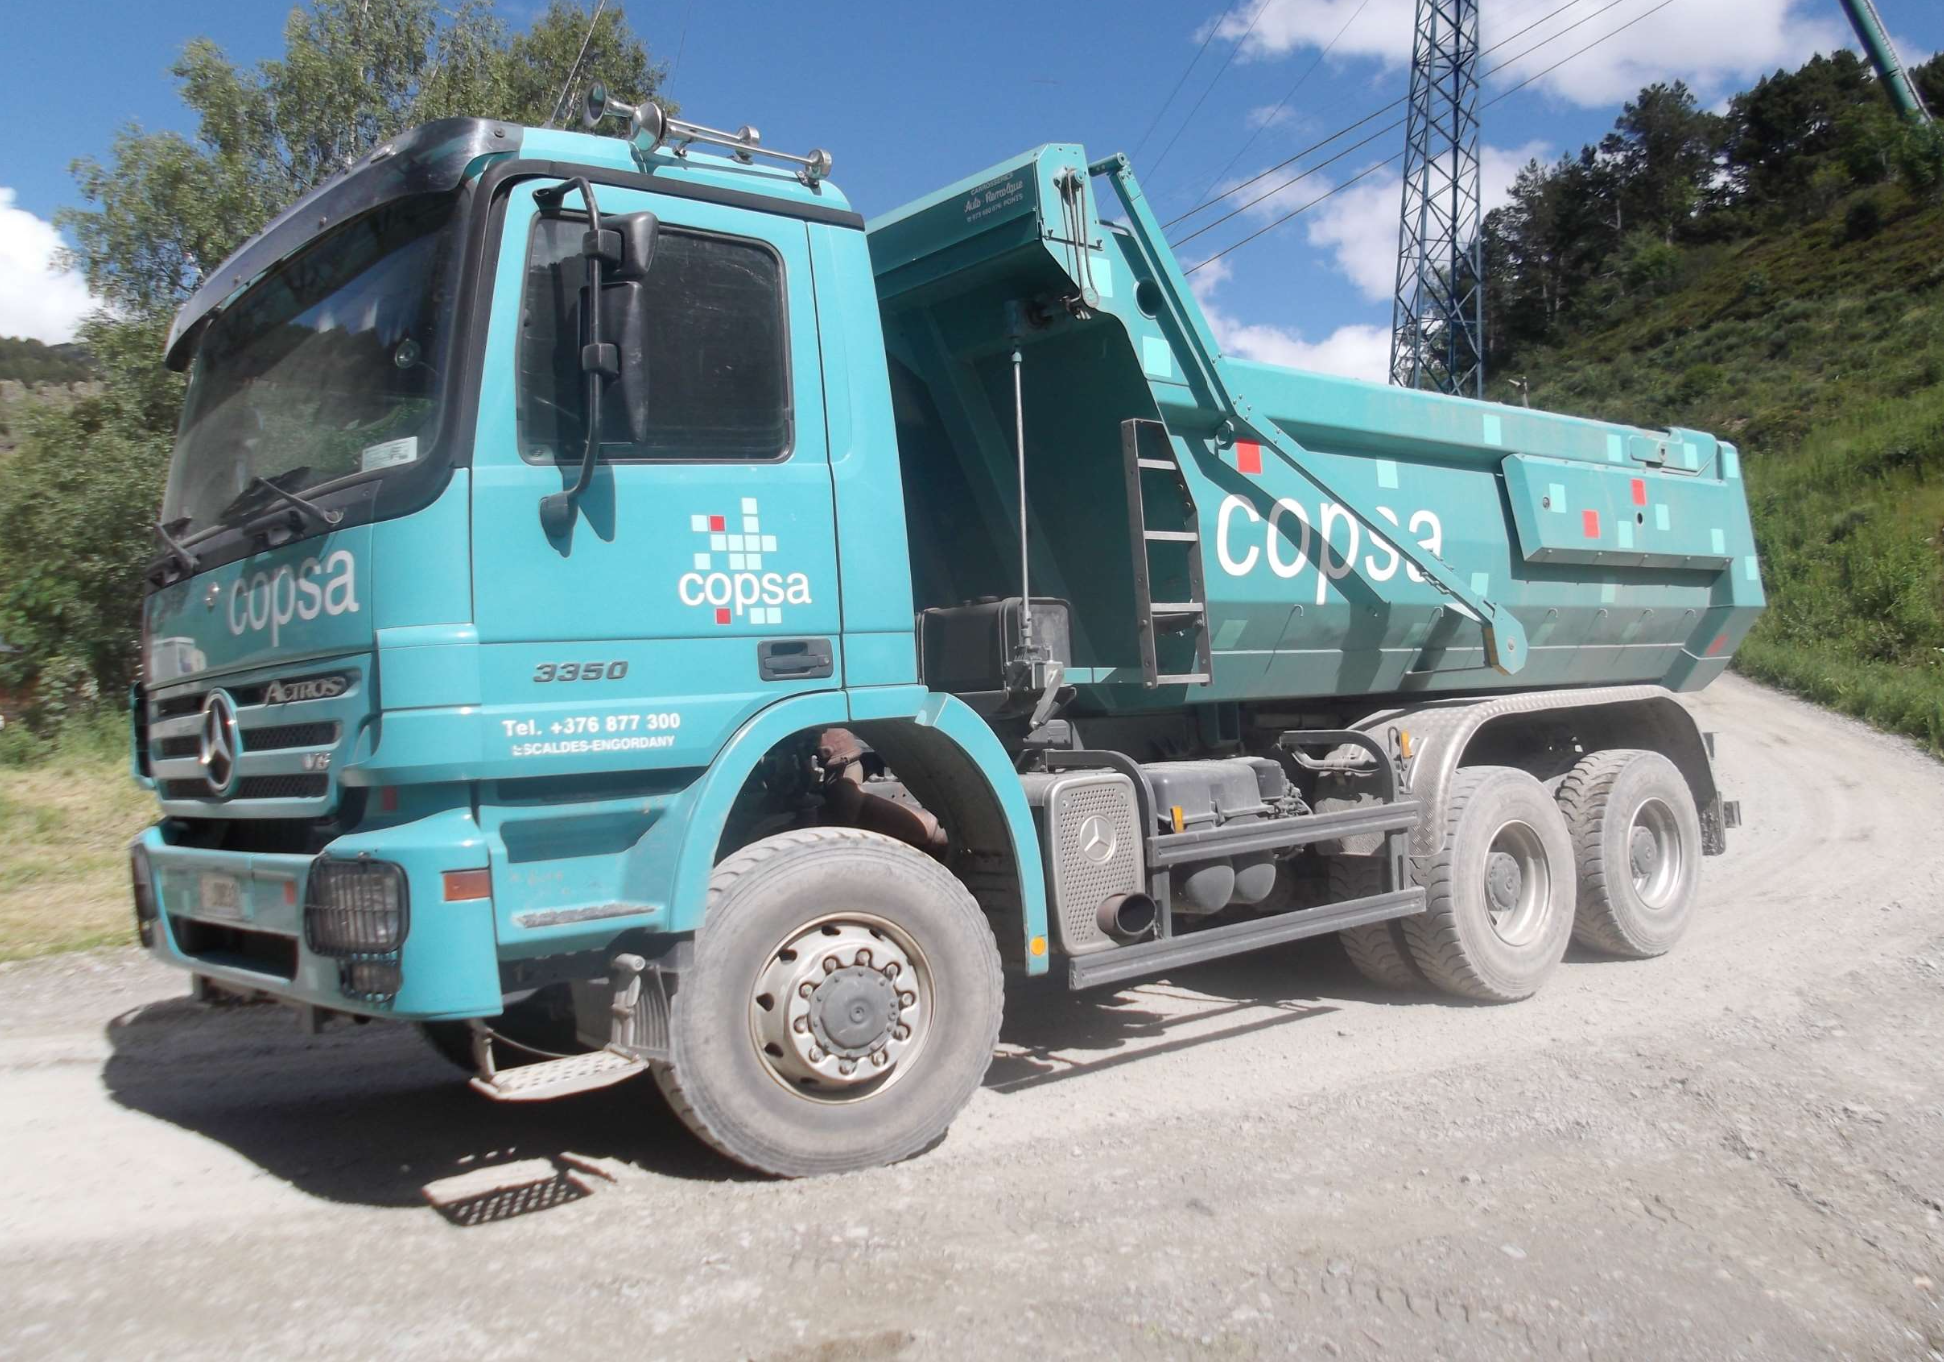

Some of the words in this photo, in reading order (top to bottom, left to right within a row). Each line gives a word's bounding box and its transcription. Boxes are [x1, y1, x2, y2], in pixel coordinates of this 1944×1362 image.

[228, 550, 359, 647] copsa
[678, 572, 812, 616] copsa
[533, 661, 629, 683] 3350
[502, 719, 543, 737] Tel.
[550, 716, 601, 735] +376
[605, 715, 640, 732] 877
[646, 713, 681, 730] 300
